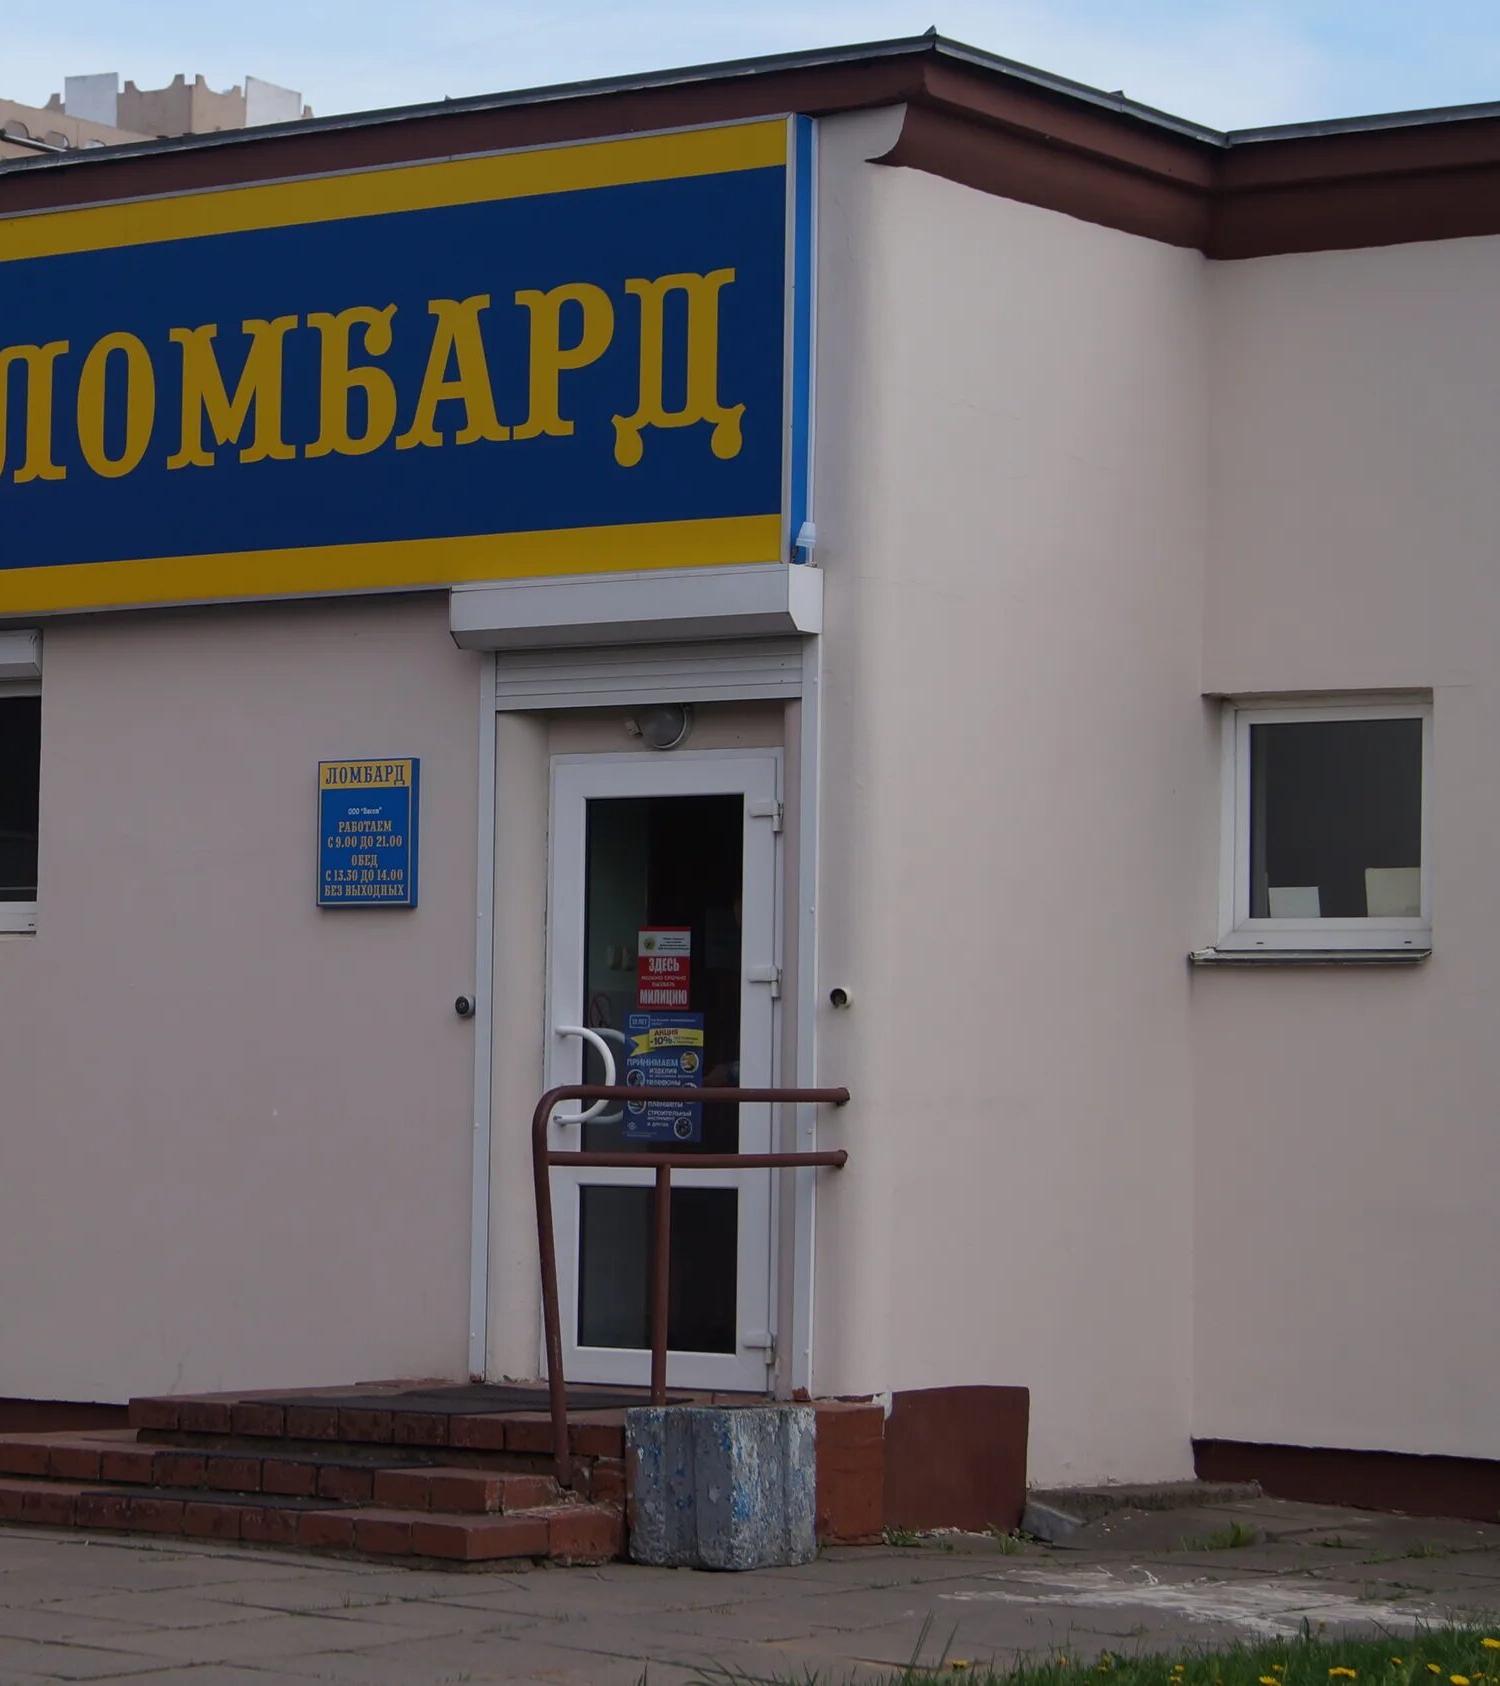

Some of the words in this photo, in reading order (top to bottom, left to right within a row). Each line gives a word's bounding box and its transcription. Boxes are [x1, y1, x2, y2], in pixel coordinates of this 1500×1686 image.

[326, 765, 405, 785] ЛОМБАРД
[339, 821, 392, 832] РАБОТАЕМ
[328, 836, 334, 848] С
[336, 836, 357, 848] 9.00
[360, 836, 373, 849] ДО
[376, 835, 402, 847] 21.00
[352, 854, 378, 868] ОБЕД
[326, 870, 331, 881] С
[361, 869, 374, 883] ДО
[378, 869, 403, 881] 14.00
[324, 885, 342, 896] БЕЗ
[346, 884, 404, 898] ВЫХОДНЫХ
[649, 957, 680, 973] ЗДЕСЬ
[640, 990, 688, 1006] МИЛИЦИЮ
[627, 1058, 679, 1067] ПРИНИМАЕМ
